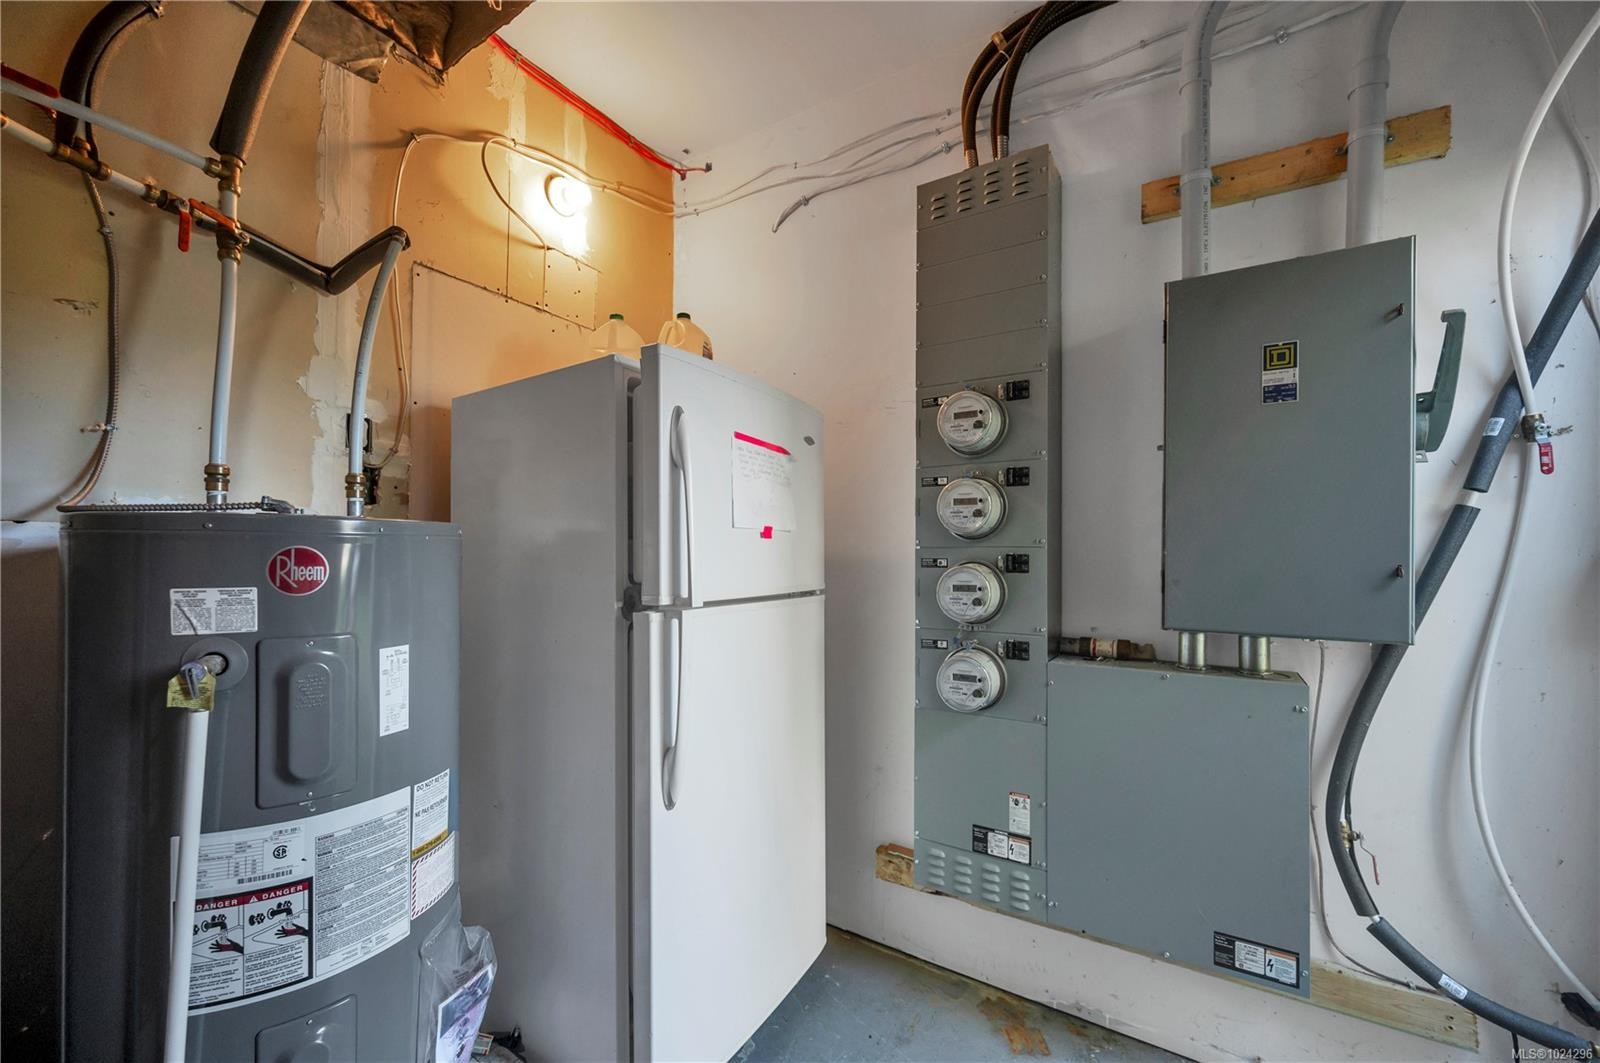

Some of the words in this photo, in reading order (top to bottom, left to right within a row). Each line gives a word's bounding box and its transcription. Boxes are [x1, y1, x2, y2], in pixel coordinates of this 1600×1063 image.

[276, 548, 325, 588] Rheem
[262, 885, 303, 899] DANGER
[196, 899, 238, 911] DANGER
